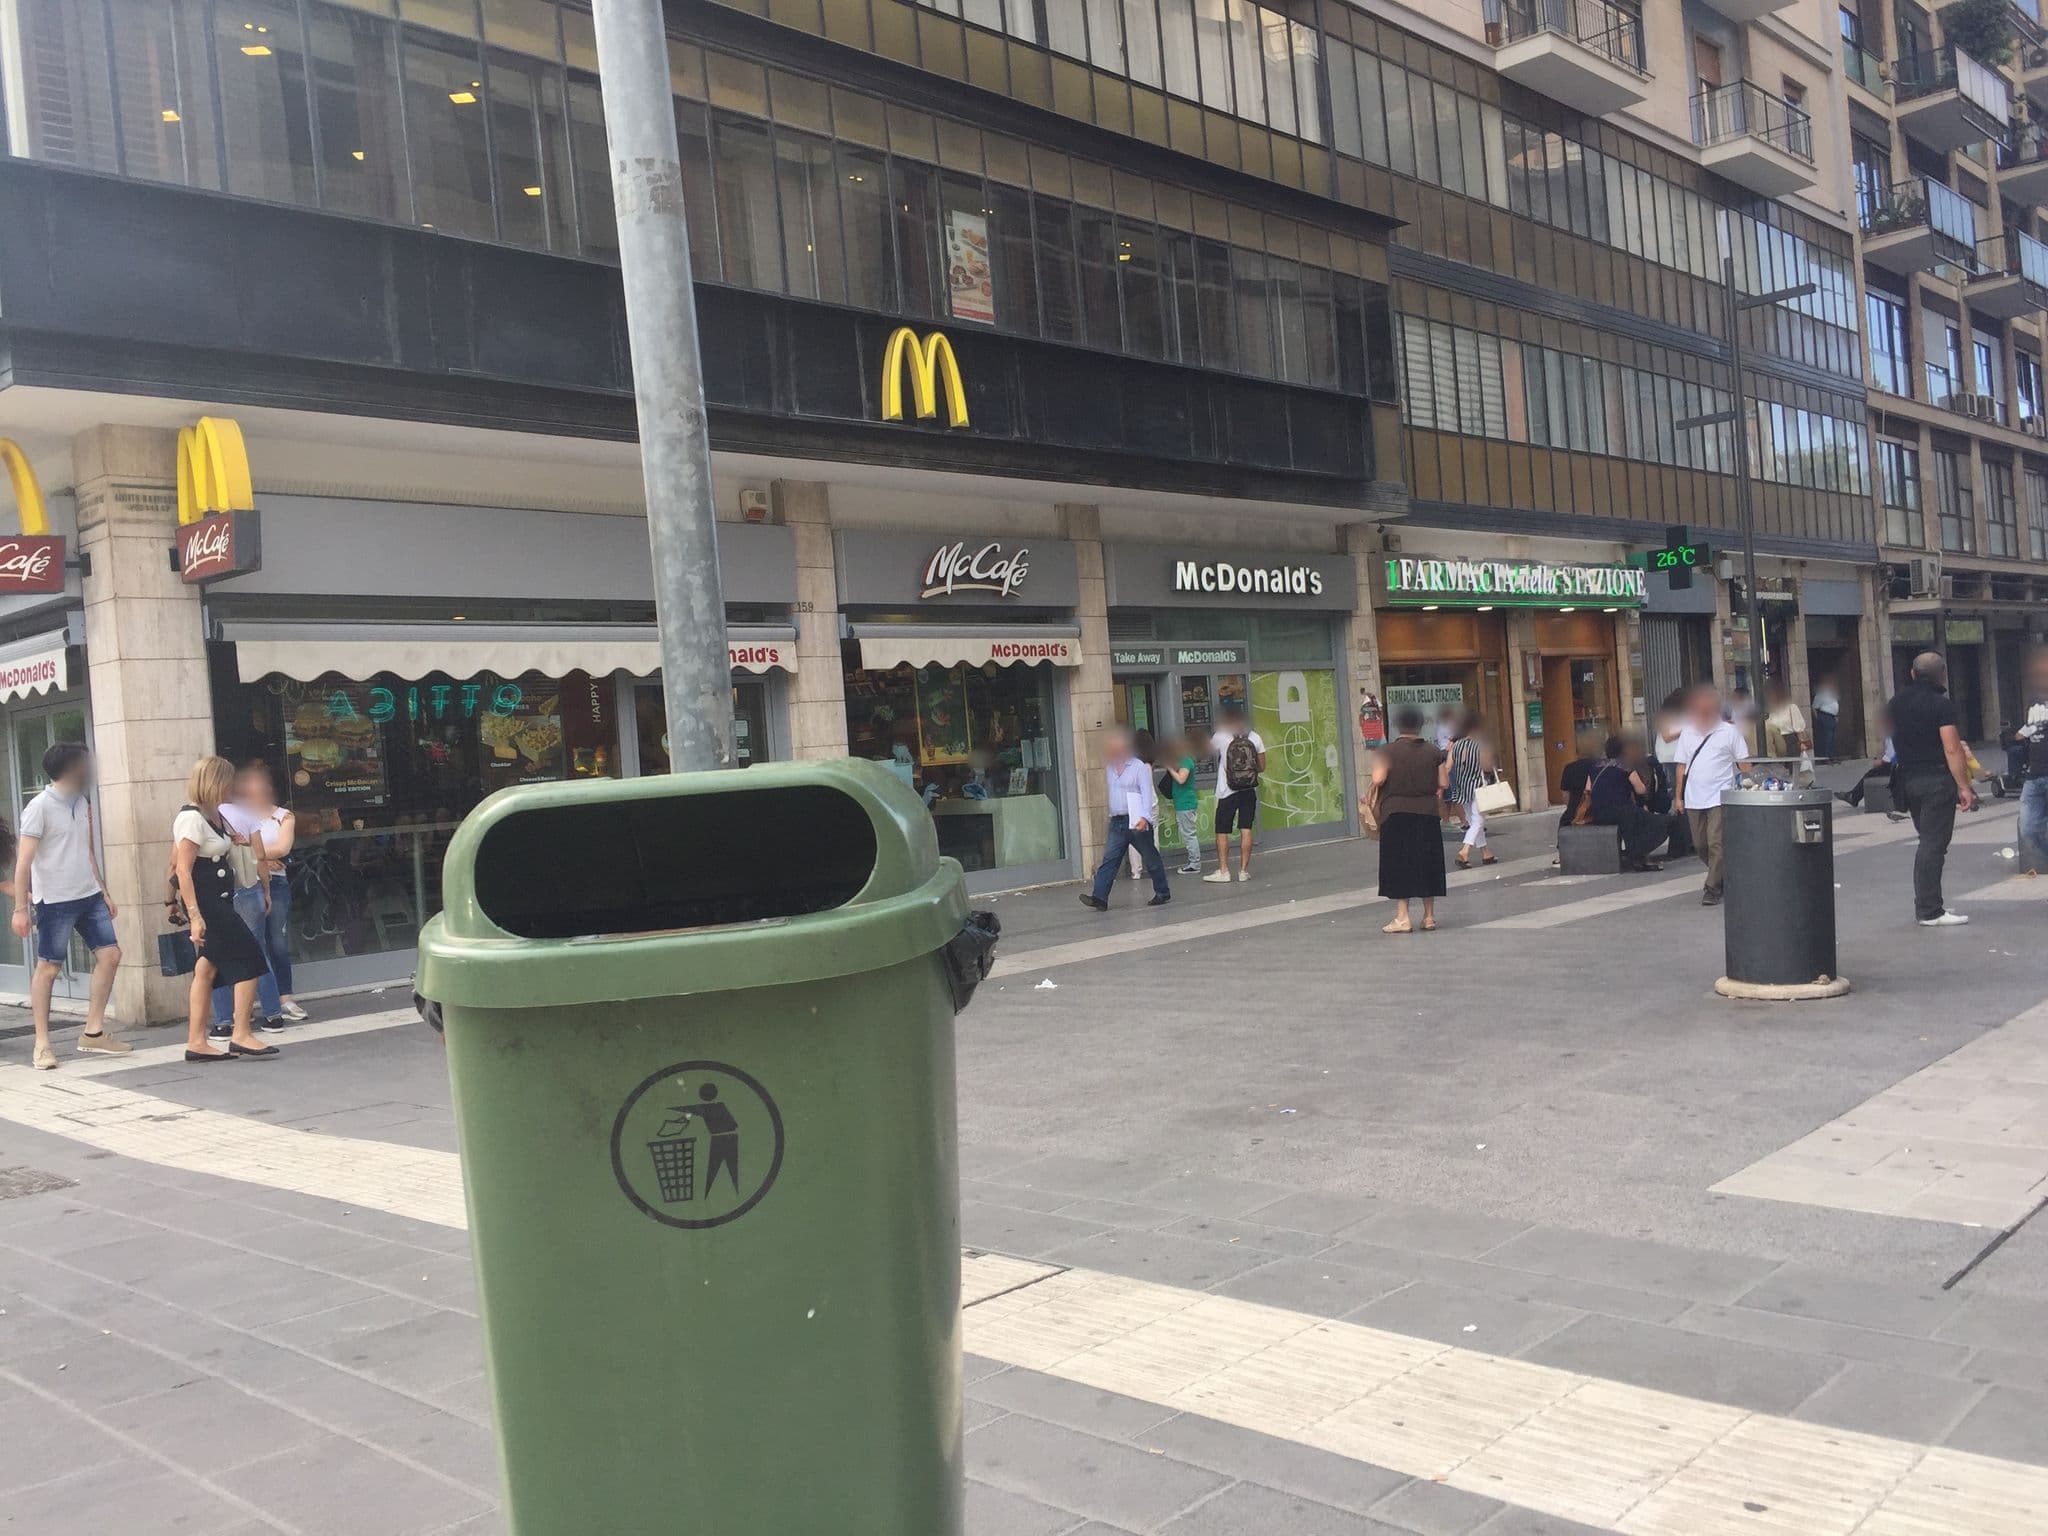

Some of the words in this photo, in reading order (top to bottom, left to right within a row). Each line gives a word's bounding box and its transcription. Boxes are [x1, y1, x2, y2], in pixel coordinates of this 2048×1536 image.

[185, 523, 230, 569] McCafé
[925, 542, 1029, 597] McCafé
[1176, 561, 1323, 595] McDonald's
[797, 601, 814, 613] 159
[992, 643, 1068, 658] McDonald's
[1114, 652, 1136, 664] Take
[1137, 652, 1161, 664] Away
[1178, 650, 1237, 664] McDonald's
[0, 660, 56, 689] McDonald's
[590, 683, 601, 723] HAPPY
